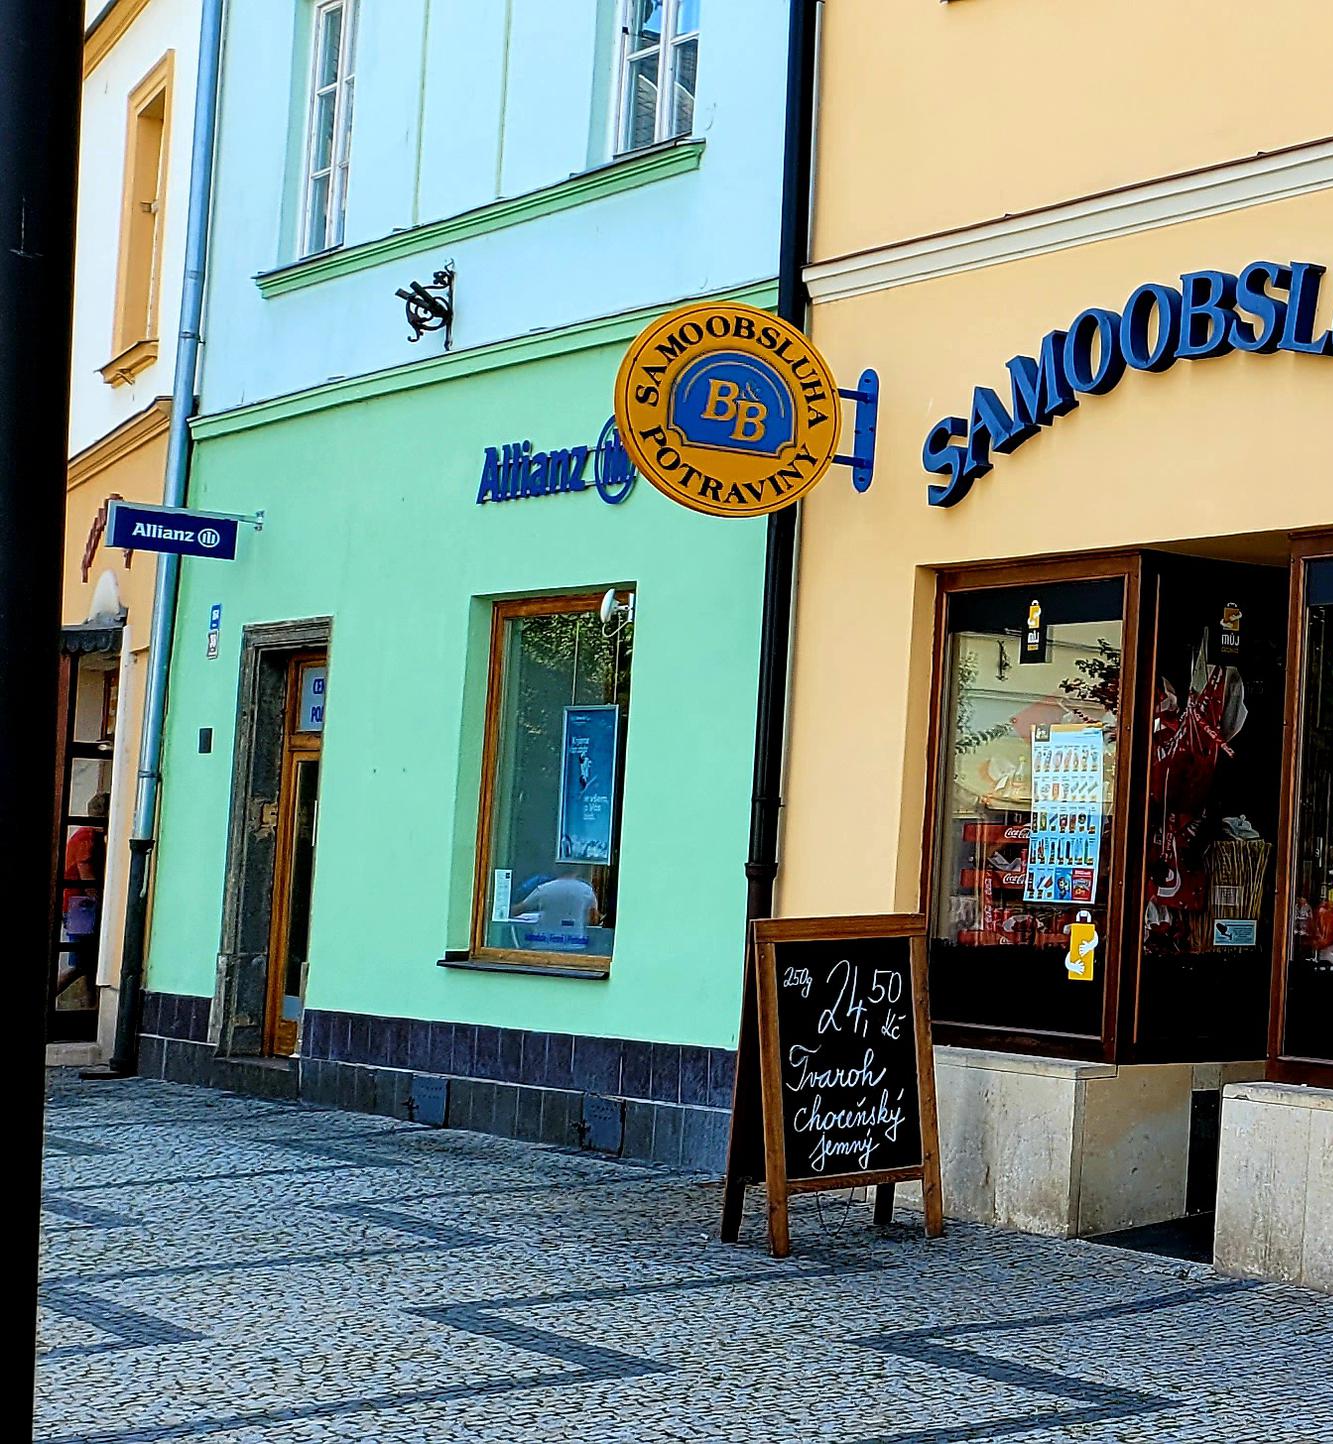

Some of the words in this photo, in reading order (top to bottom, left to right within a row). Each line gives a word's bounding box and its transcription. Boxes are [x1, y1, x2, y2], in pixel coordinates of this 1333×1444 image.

[635, 315, 829, 429] SAMOOBSLUHA
[476, 440, 588, 504] Allianz
[639, 424, 819, 504] POTRAVINY
[132, 522, 195, 542] Allianz
[783, 966, 813, 998] 250g
[786, 1044, 886, 1091] Tvaroh
